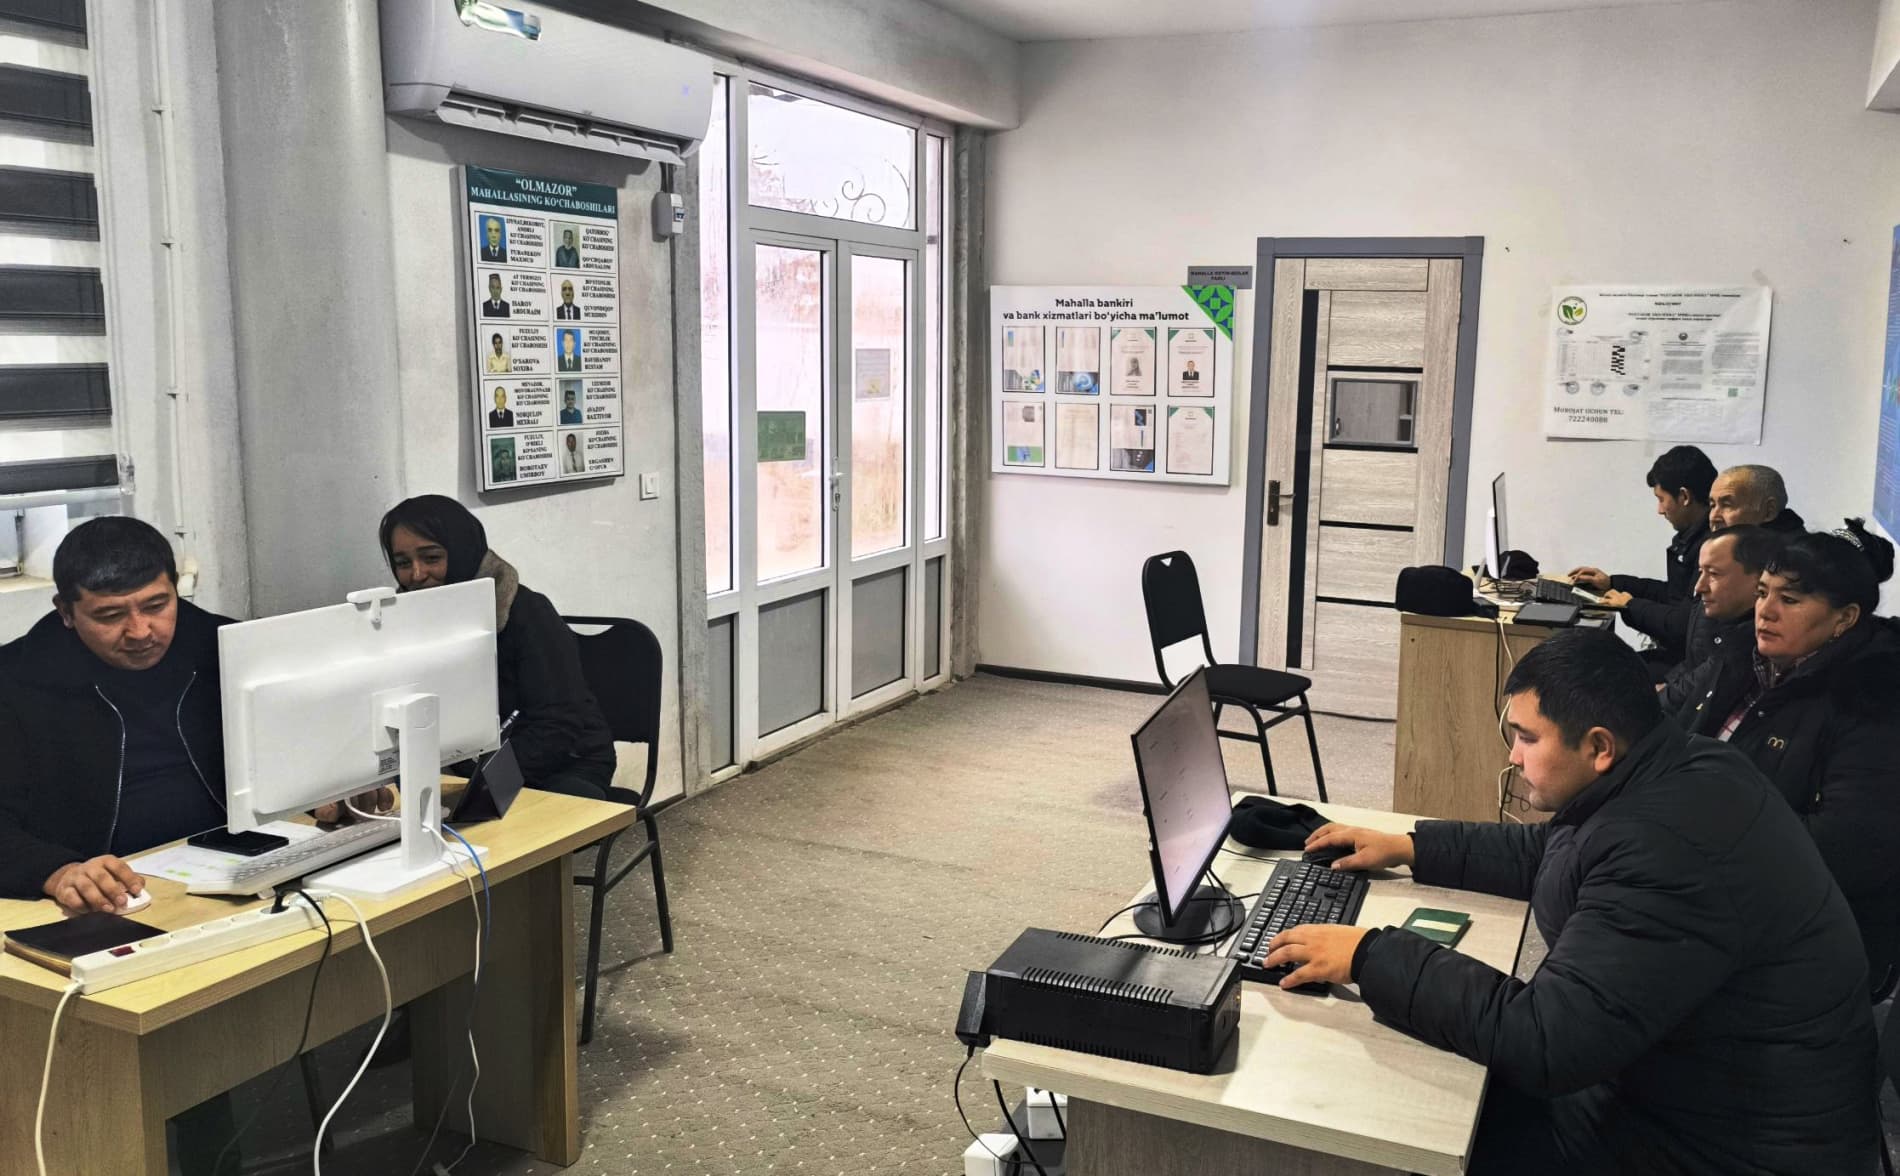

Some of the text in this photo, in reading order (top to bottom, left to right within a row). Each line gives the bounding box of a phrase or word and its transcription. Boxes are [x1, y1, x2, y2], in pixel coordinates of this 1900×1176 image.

[471, 186, 542, 205] MAHALLASINING
[1056, 298, 1134, 308] Mahalla bankiri
[1016, 310, 1041, 320] bank
[1043, 310, 1092, 320] xizmatlari
